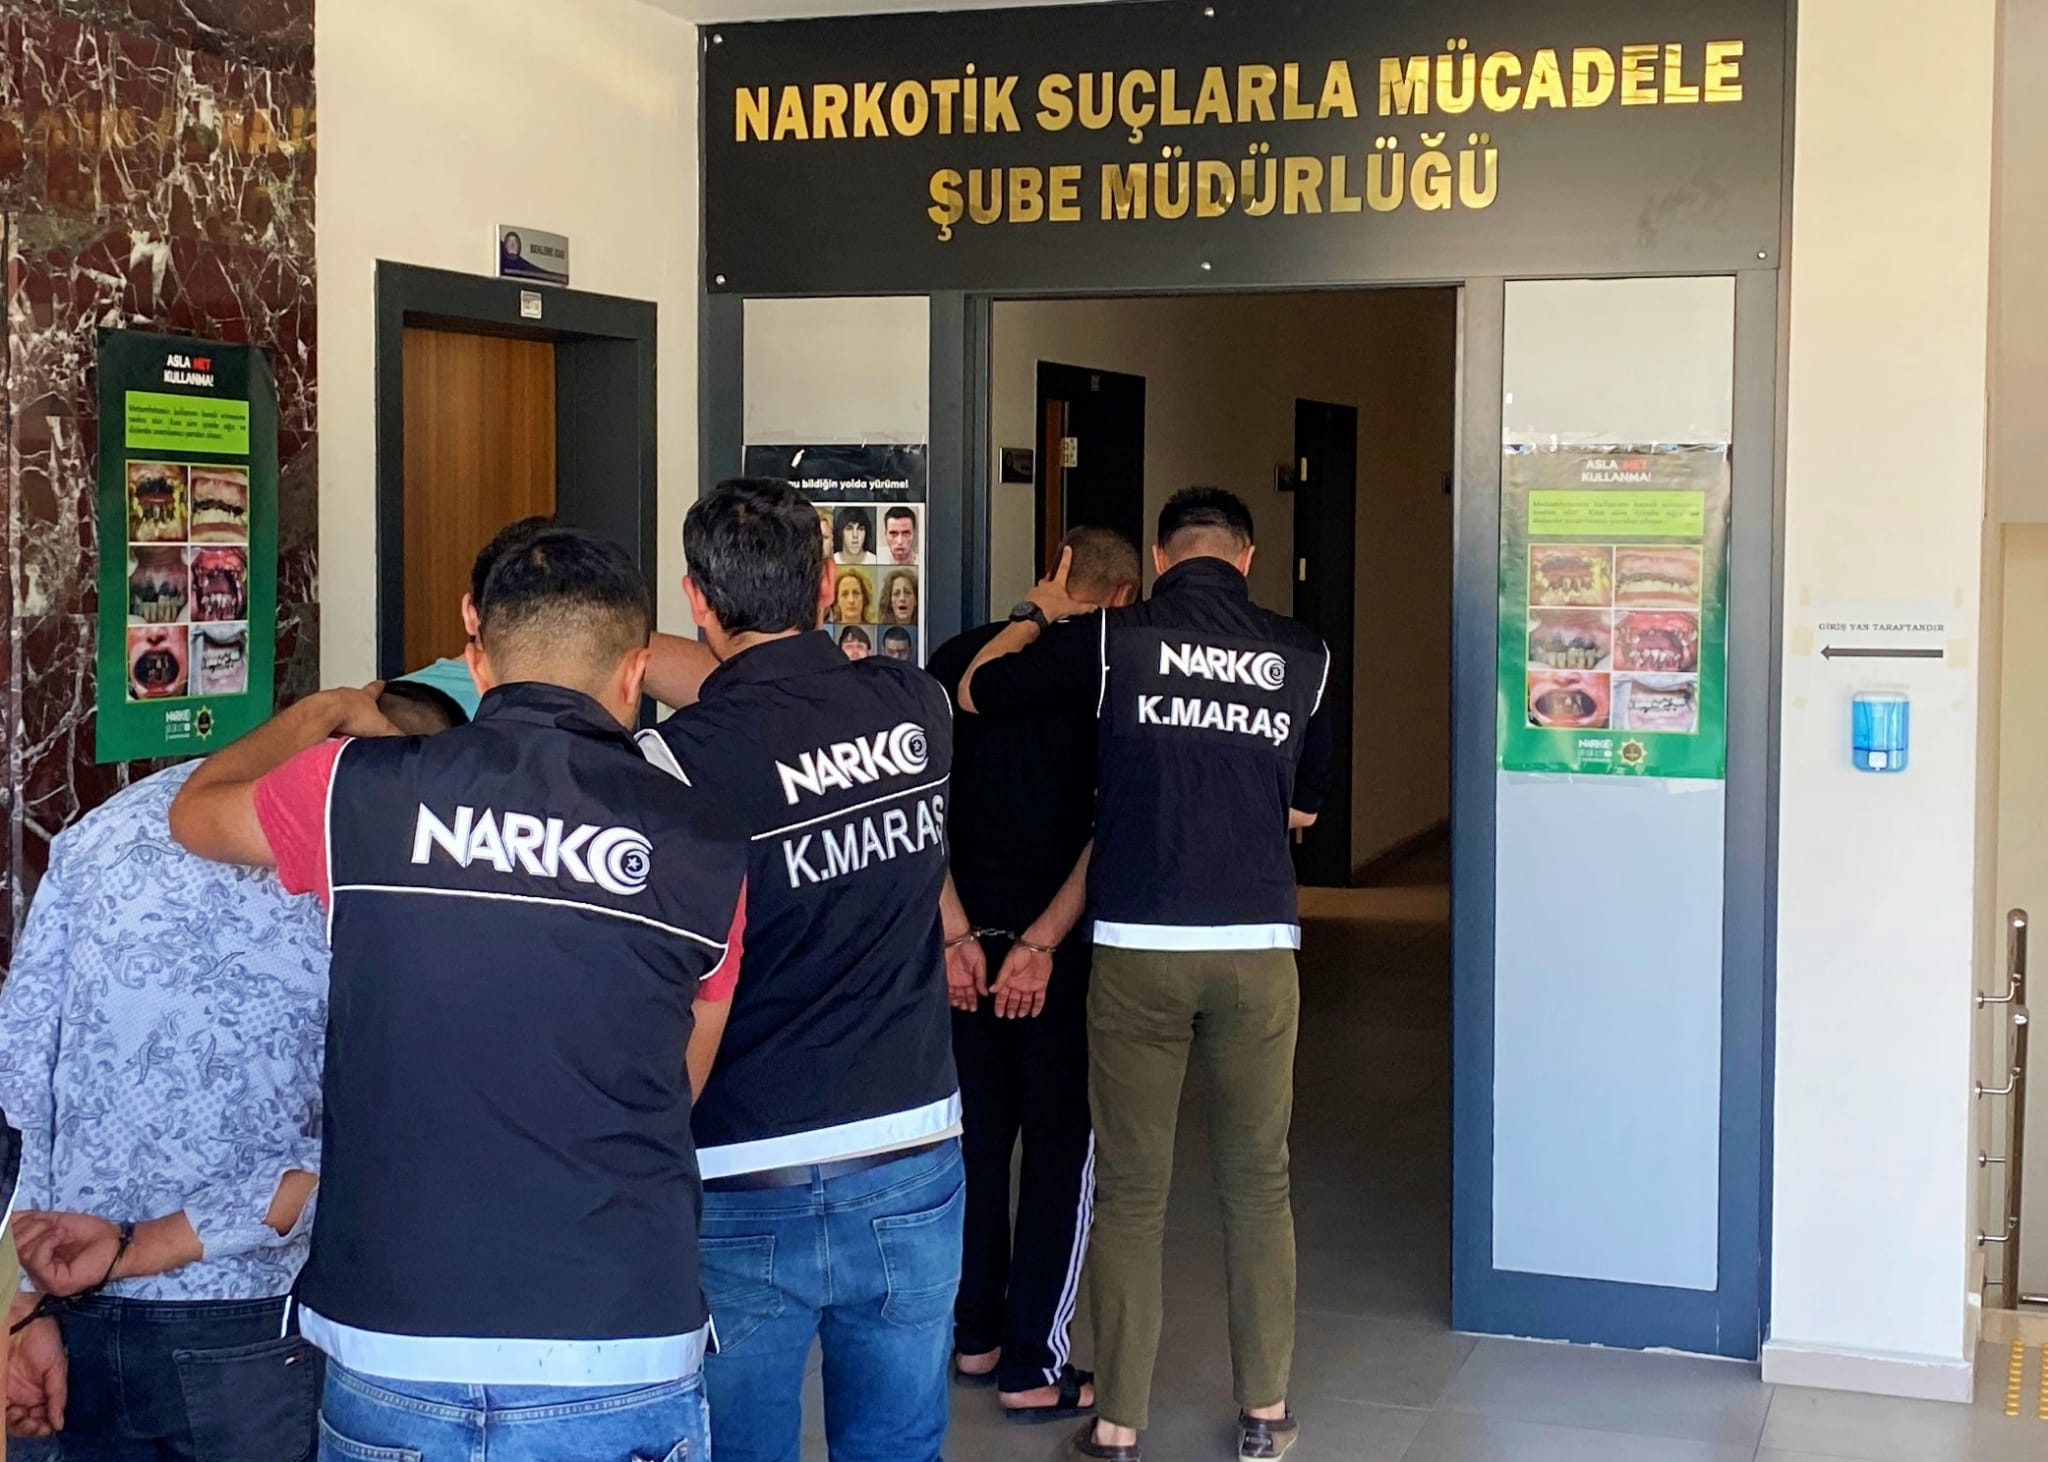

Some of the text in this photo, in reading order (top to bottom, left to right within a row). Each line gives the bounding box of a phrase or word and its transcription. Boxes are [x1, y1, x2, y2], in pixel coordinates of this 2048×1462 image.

[735, 37, 1745, 144] NARKOTİK SUÇLARLA MÜCADELE
[926, 131, 1499, 242] ŞUBE MÜDÜRLÜĞÜ
[166, 353, 191, 368] ASLA
[163, 369, 215, 387] KULLANMA!
[1585, 459, 1619, 470] ASLA
[801, 478, 838, 491] bildiğin
[840, 478, 867, 490] yolda
[869, 478, 908, 490] yürüme!
[1581, 471, 1653, 482] KULLANMA!
[1818, 622, 1945, 632] GİRİŞ YAN TARAFTANDIR
[1138, 695, 1291, 747] K.MARAŞ
[782, 794, 945, 889] K.MARAŞ
